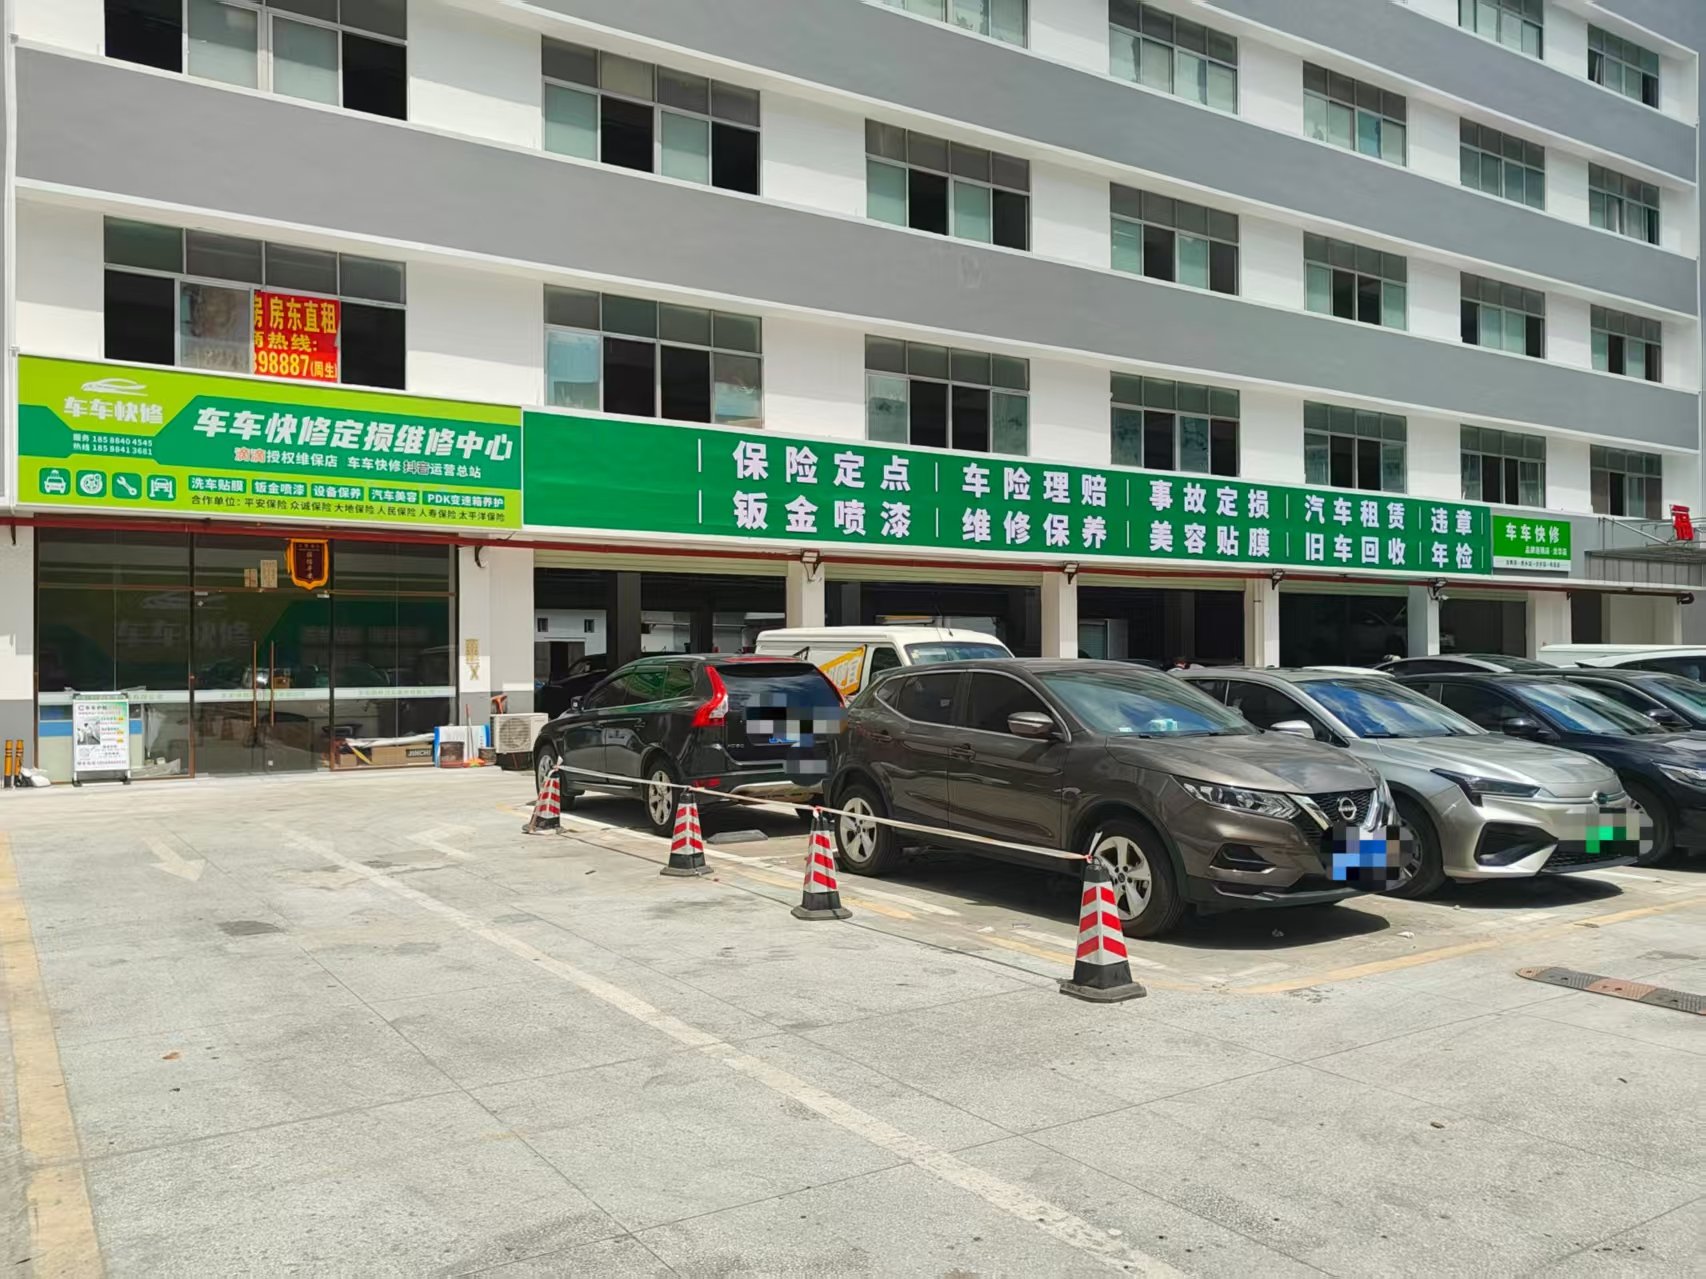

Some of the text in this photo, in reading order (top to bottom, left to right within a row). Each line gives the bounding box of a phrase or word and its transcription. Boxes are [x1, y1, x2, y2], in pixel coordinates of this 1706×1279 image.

[63, 395, 163, 424] 车车快修
[92, 435, 108, 443] 185
[131, 438, 153, 447] 4545
[193, 406, 513, 462] 车车快修定损维修中心
[191, 476, 504, 508] 洗车贴膜 钣金喷漆 设备保养 汽车美容 PDK变速箱养护
[732, 440, 1473, 536] 保险定点 车险理赔 事故定损 汽车租赁 违章
[334, 502, 375, 515] 大地保险
[377, 505, 416, 517] 人民保险
[458, 511, 505, 522] 太平洋保险
[732, 491, 1473, 570] 钣金喷漆 维修保养 美容贴膜 旧车回收 年检
[1505, 522, 1560, 544] 车车快修
